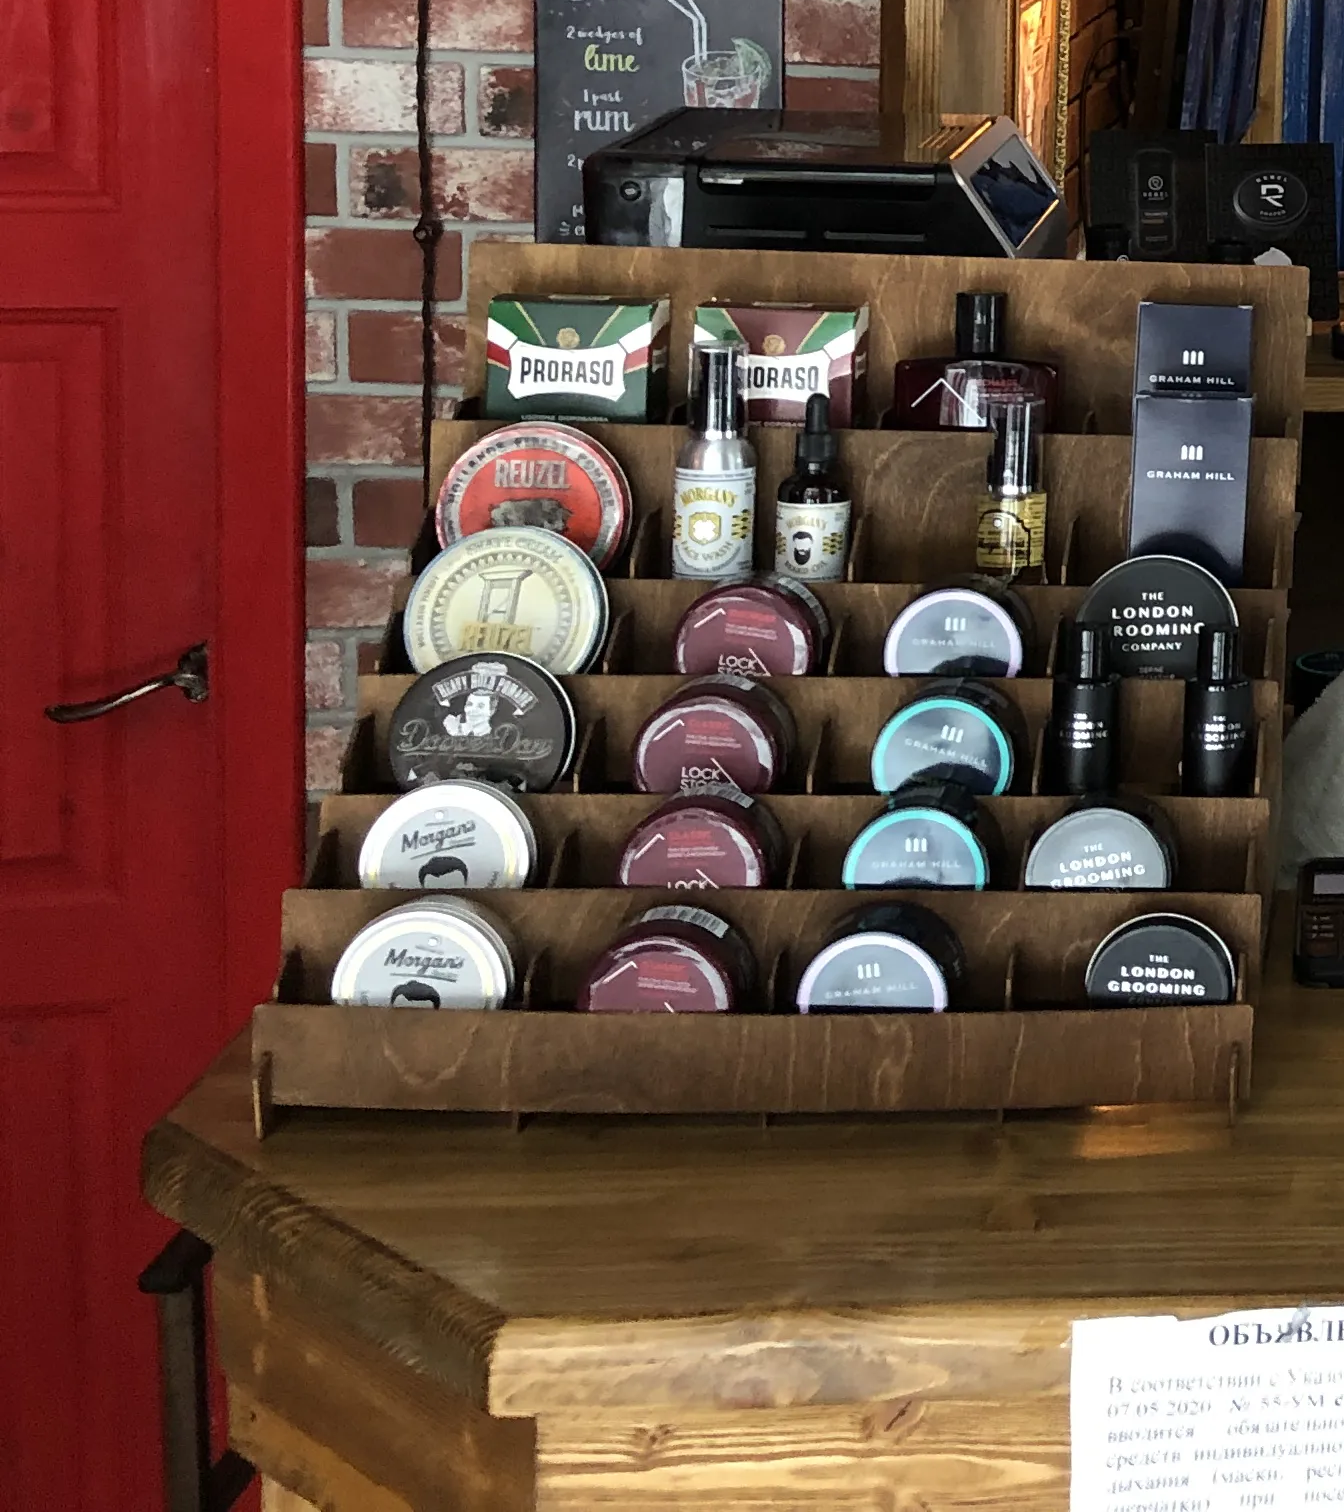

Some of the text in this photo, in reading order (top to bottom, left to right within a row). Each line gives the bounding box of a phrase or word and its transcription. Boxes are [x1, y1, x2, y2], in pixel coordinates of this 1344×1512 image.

[566, 25, 575, 39] 2
[628, 27, 645, 46] of
[584, 43, 640, 73] lime
[574, 109, 636, 133] rum
[519, 356, 614, 387] PRORASO
[747, 365, 820, 392] ORASO
[1149, 374, 1236, 386] GRAHAM HILL
[494, 459, 572, 489] REUZEL
[1146, 470, 1236, 481] GRAHAM HILL
[1140, 591, 1165, 602] THE
[1111, 604, 1194, 620] LONDON
[911, 637, 997, 649] GRAHAM HILL
[1121, 641, 1183, 652] COMPANY
[718, 653, 758, 669] LOCK
[470, 672, 497, 690] HOLD
[496, 677, 535, 709] POMADE
[904, 737, 989, 769] GRAHAM HILL
[681, 766, 721, 781] LOCK
[1083, 842, 1104, 852] THE
[870, 859, 962, 870] GRAHAM HILL
[1058, 849, 1133, 874] LONDON
[1051, 862, 1147, 888] GROOMING
[1149, 954, 1170, 963] THE
[1120, 965, 1195, 980] LONDON
[824, 981, 919, 1000] GRAHAM HILL
[1107, 979, 1206, 996] GROOMING
